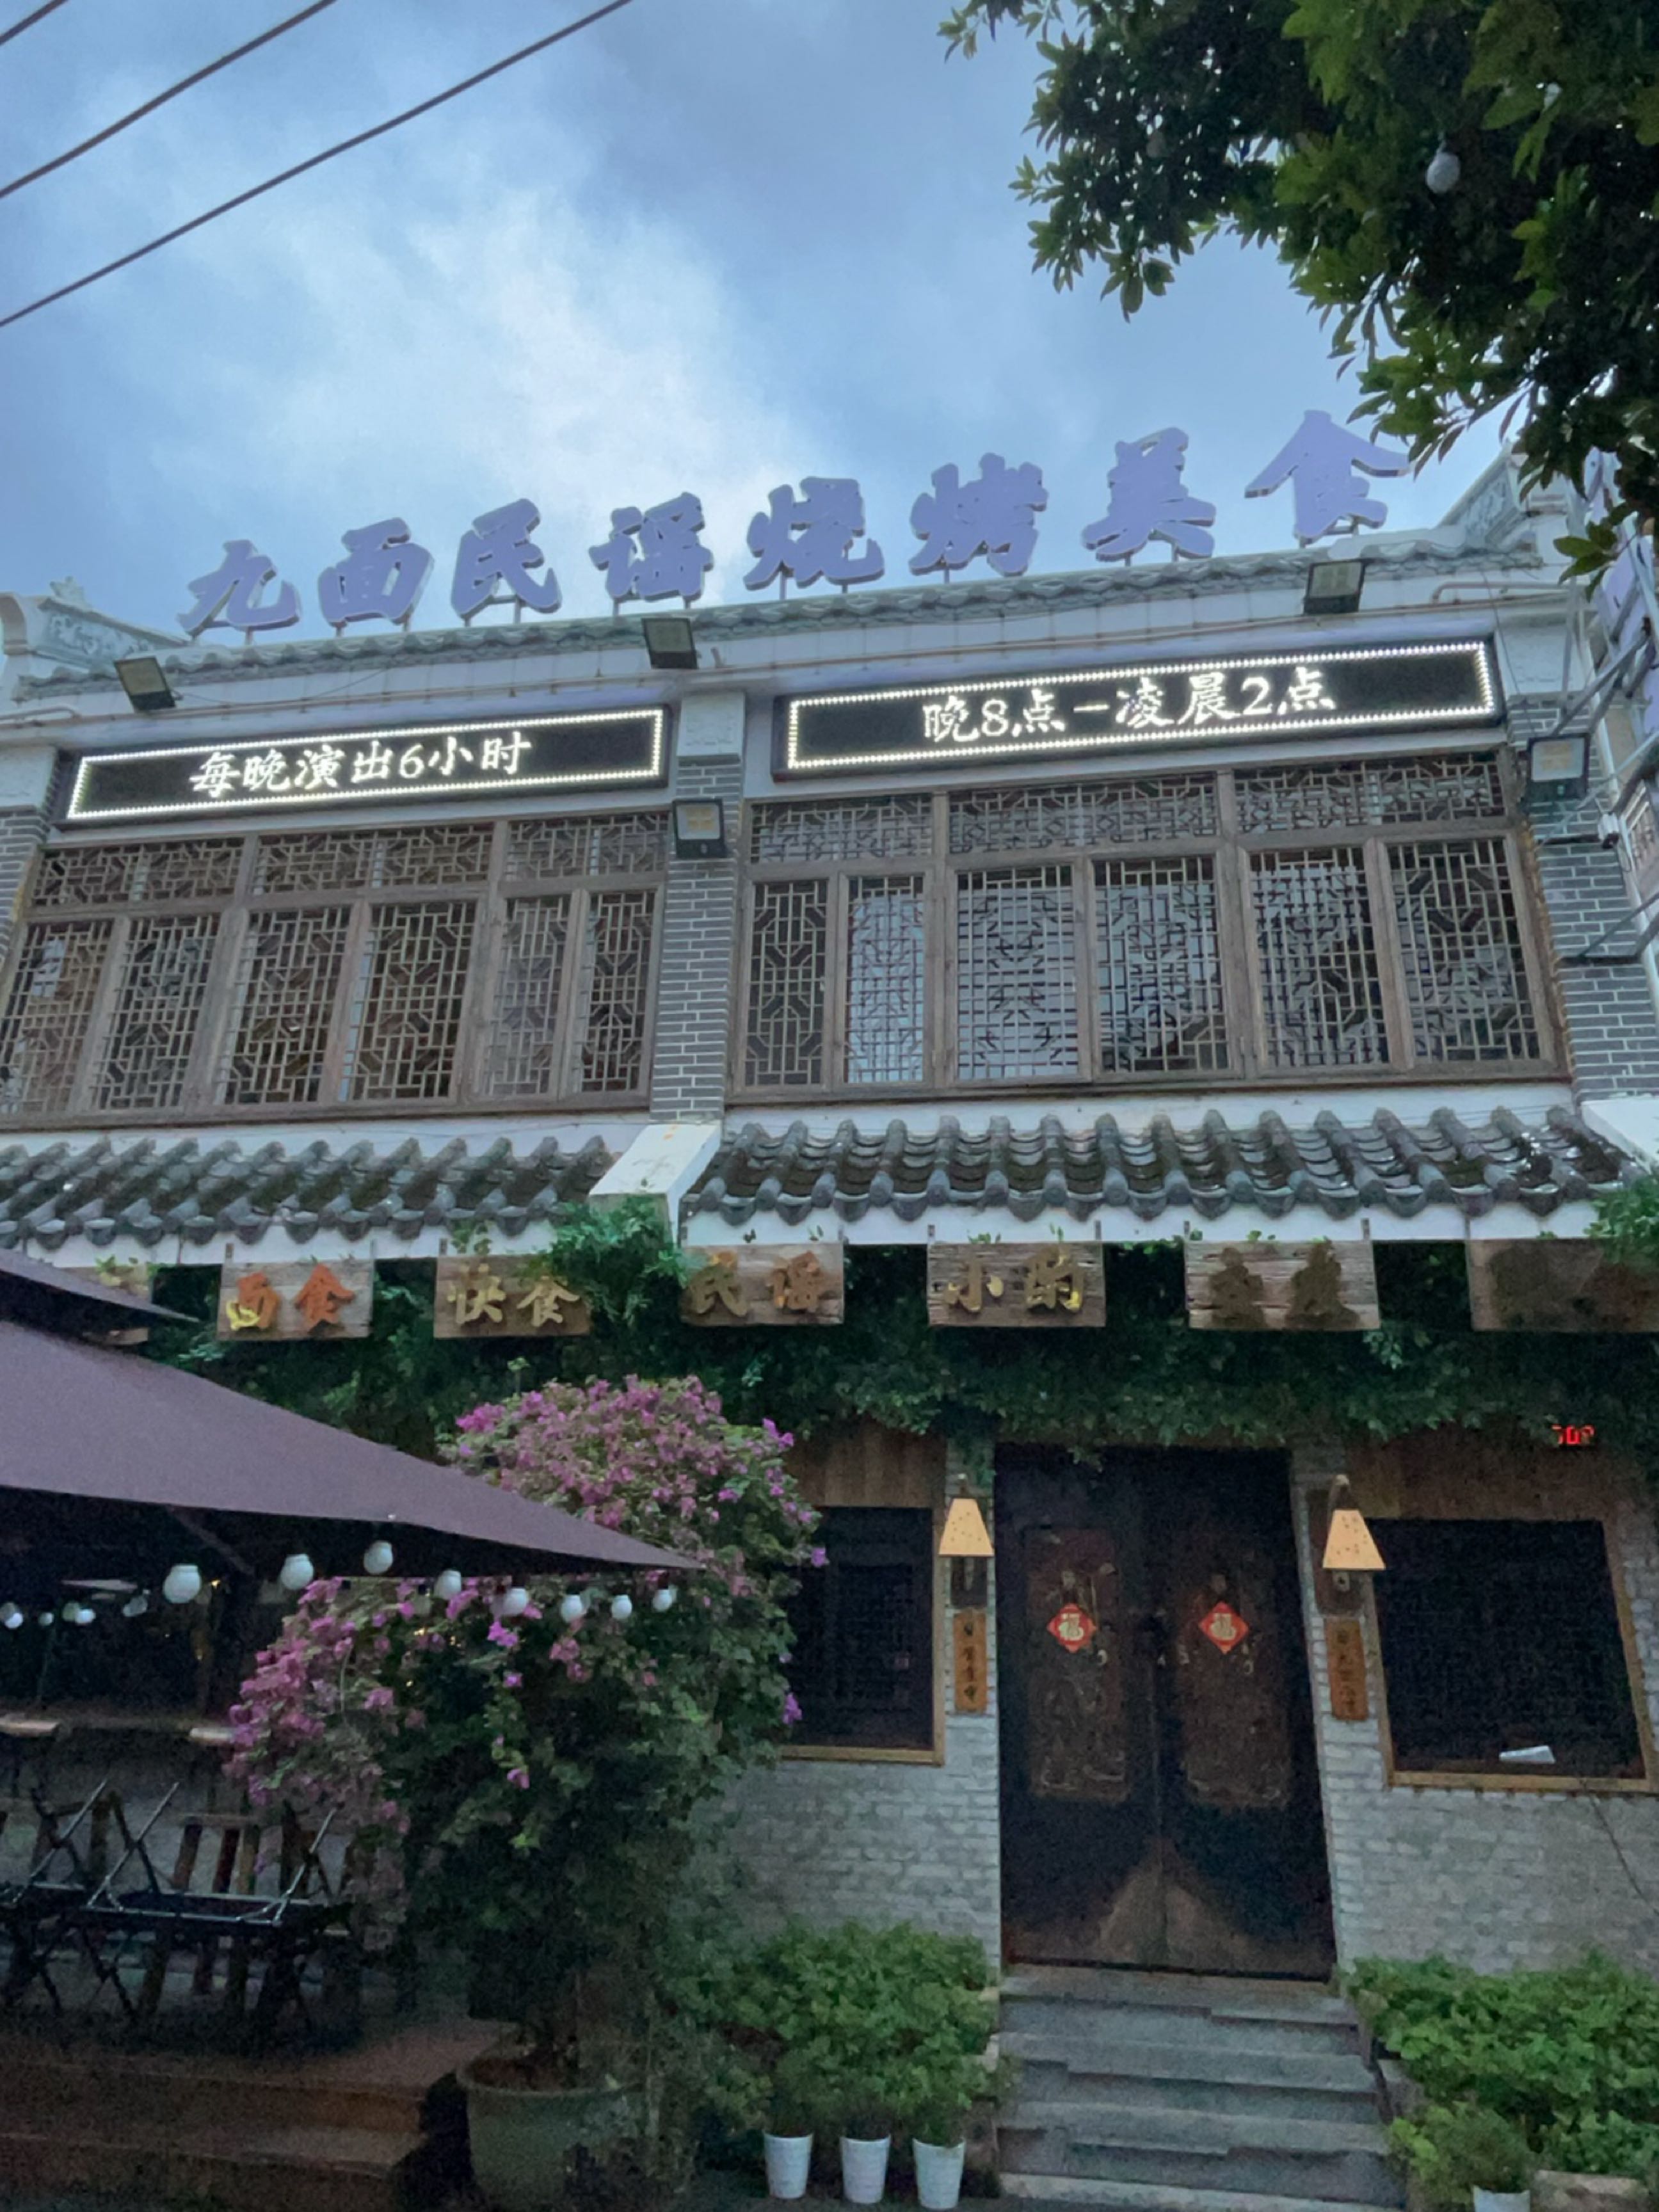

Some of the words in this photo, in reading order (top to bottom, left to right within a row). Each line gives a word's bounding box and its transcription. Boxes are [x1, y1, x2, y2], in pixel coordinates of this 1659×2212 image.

[189, 731, 532, 797] 每晚演出6小时
